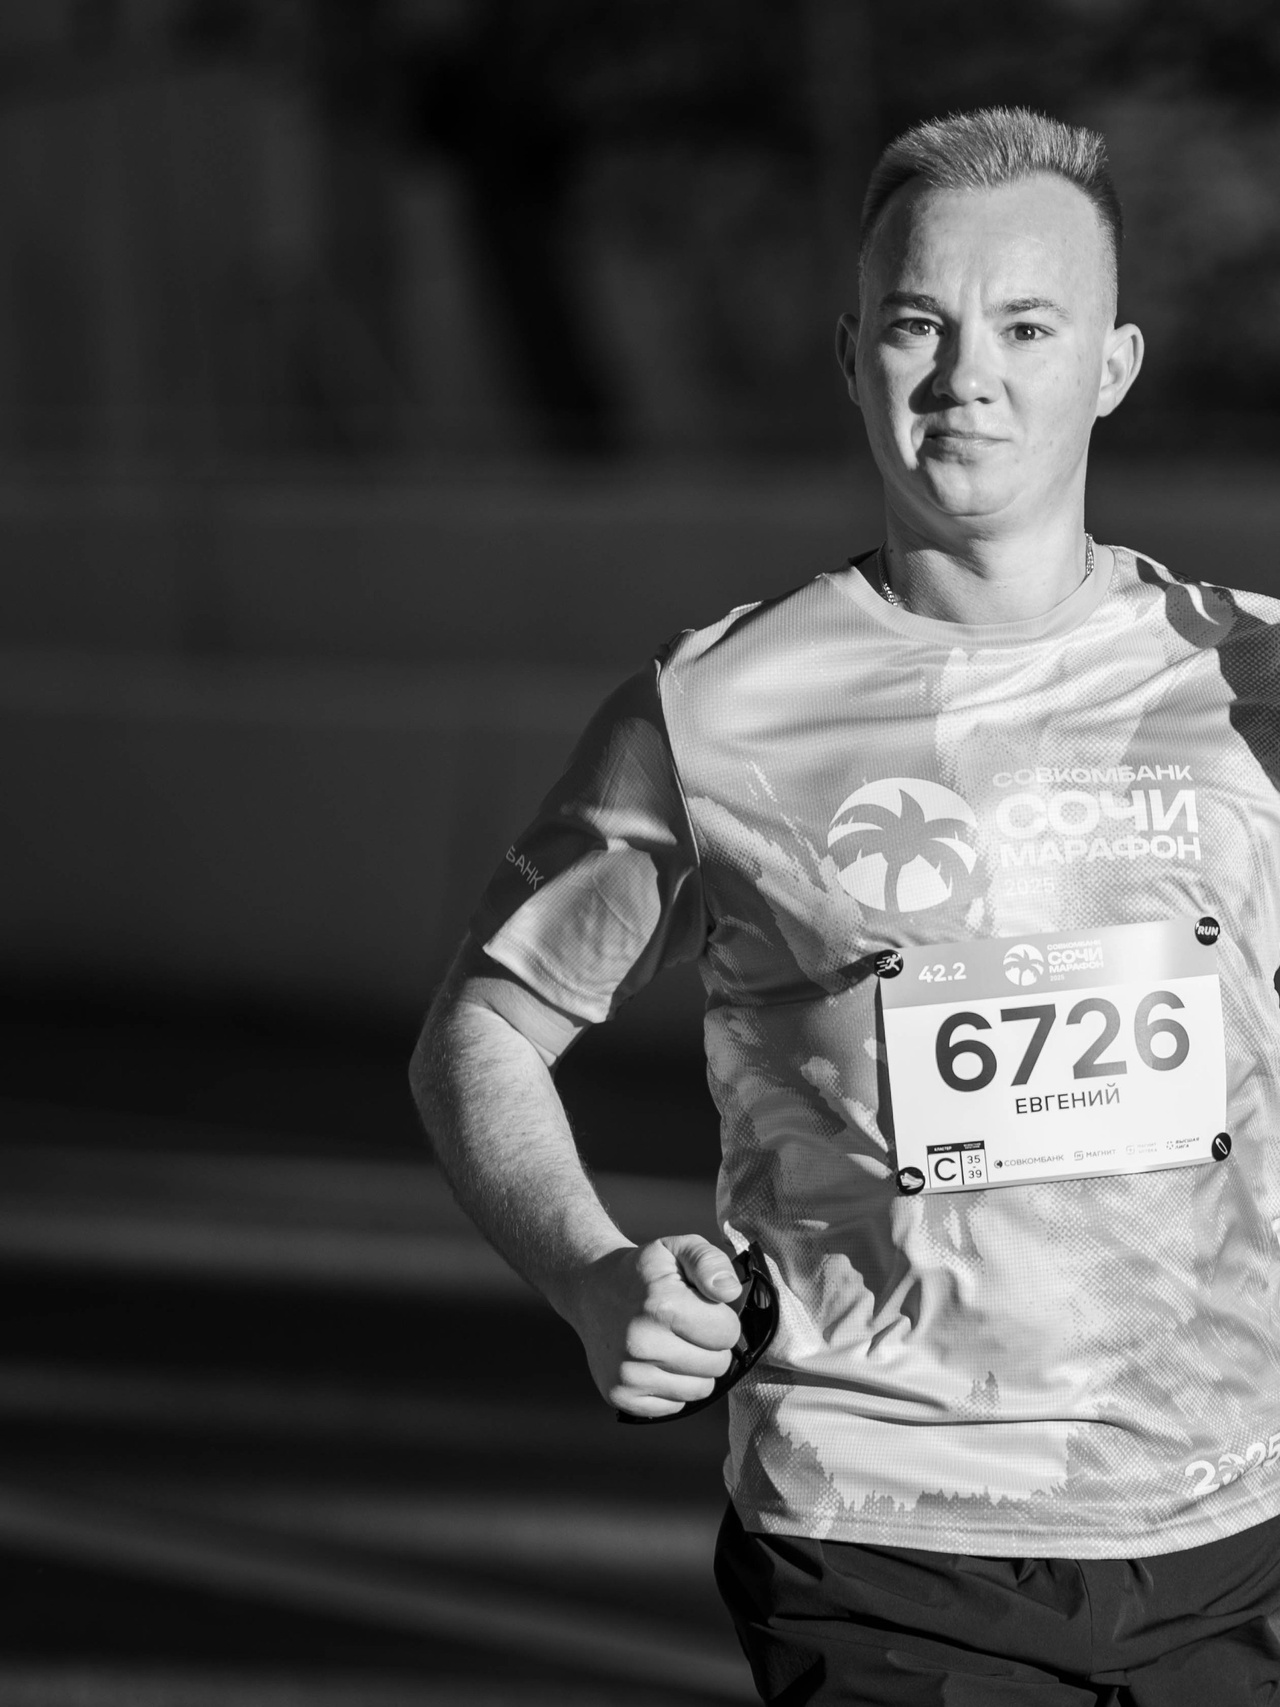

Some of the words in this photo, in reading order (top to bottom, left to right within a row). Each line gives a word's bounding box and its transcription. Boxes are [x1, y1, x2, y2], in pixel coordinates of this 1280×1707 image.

[992, 765, 1193, 787] СОВКОМБАНК
[996, 789, 1198, 839] СОЧИ
[1000, 835, 1201, 867] МАРАФОН
[1003, 876, 1055, 896] 2025
[1197, 925, 1219, 936] RUN
[1048, 947, 1103, 966] СОЧИ
[918, 962, 967, 983] 42.2
[1049, 961, 1104, 973] МАРАФОН
[935, 990, 1190, 1092] 6726
[1015, 1082, 1121, 1114] ЕВГЕНИЙ
[967, 1155, 981, 1165] 35
[1004, 1155, 1064, 1167] СОВКОМБАНК
[1086, 1149, 1116, 1159] МАГНИТ
[968, 1169, 982, 1180] 39
